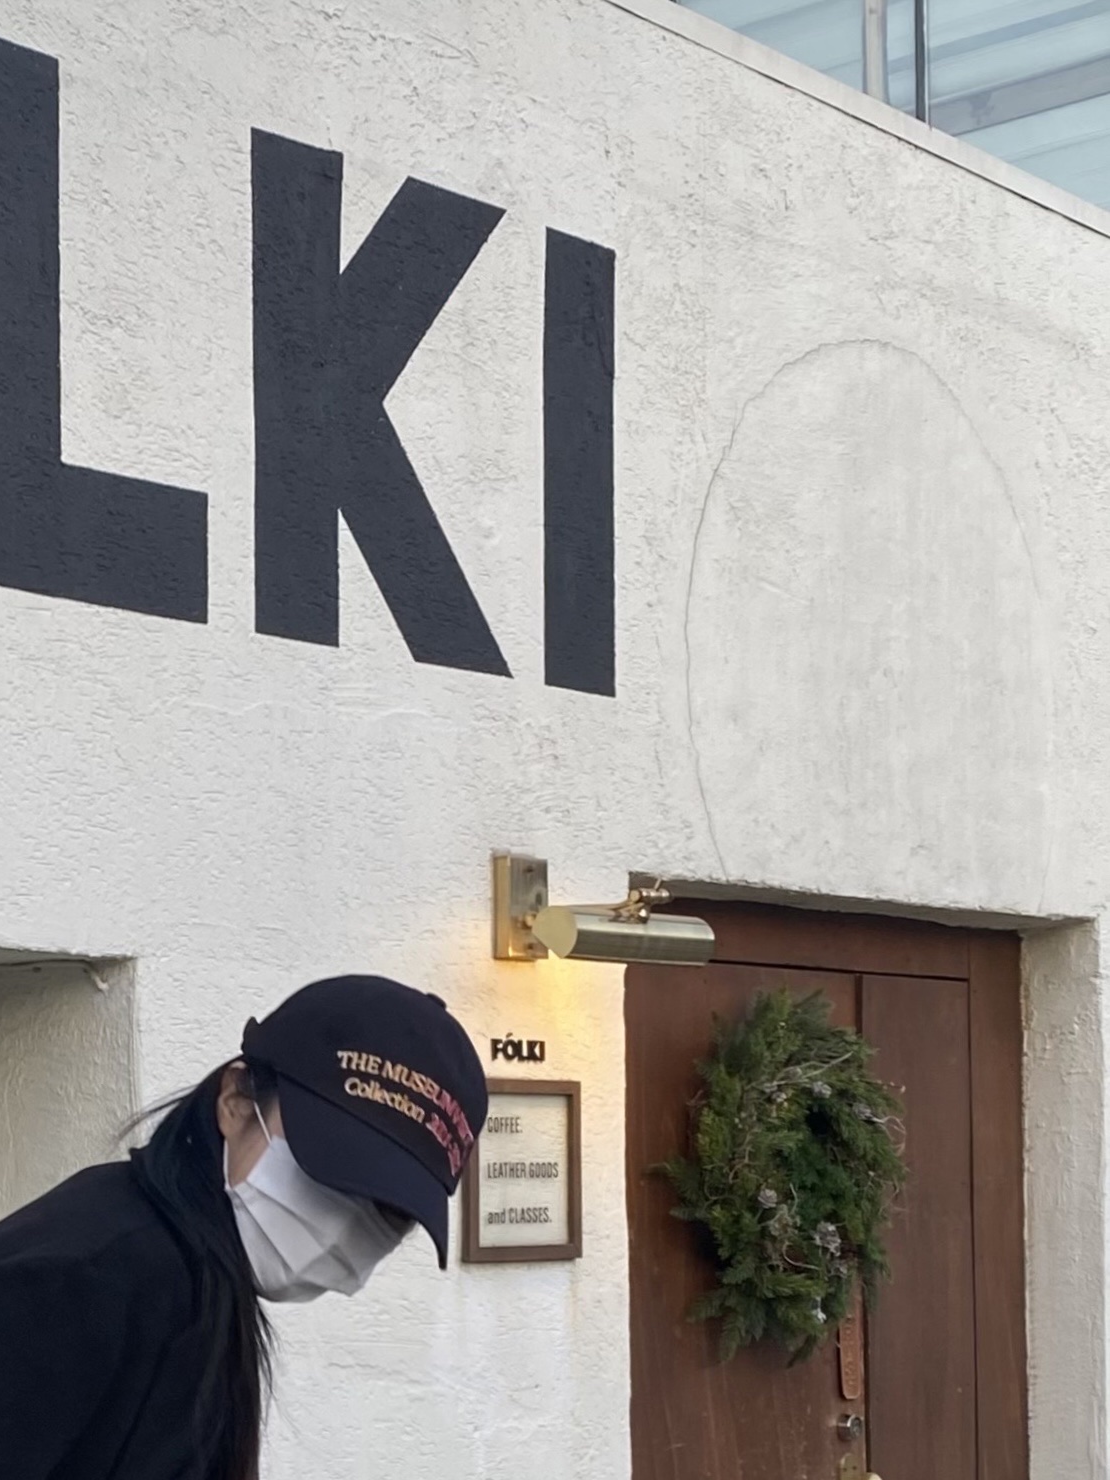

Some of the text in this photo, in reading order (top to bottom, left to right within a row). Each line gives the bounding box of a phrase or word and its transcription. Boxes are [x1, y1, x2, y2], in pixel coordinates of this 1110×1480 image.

[337, 1050, 382, 1075] THE
[344, 1077, 426, 1123] Collection
[487, 1116, 523, 1133] COFFEE.
[487, 1162, 559, 1179] LEATHER GOODS
[487, 1207, 552, 1224] and CLASSES.
